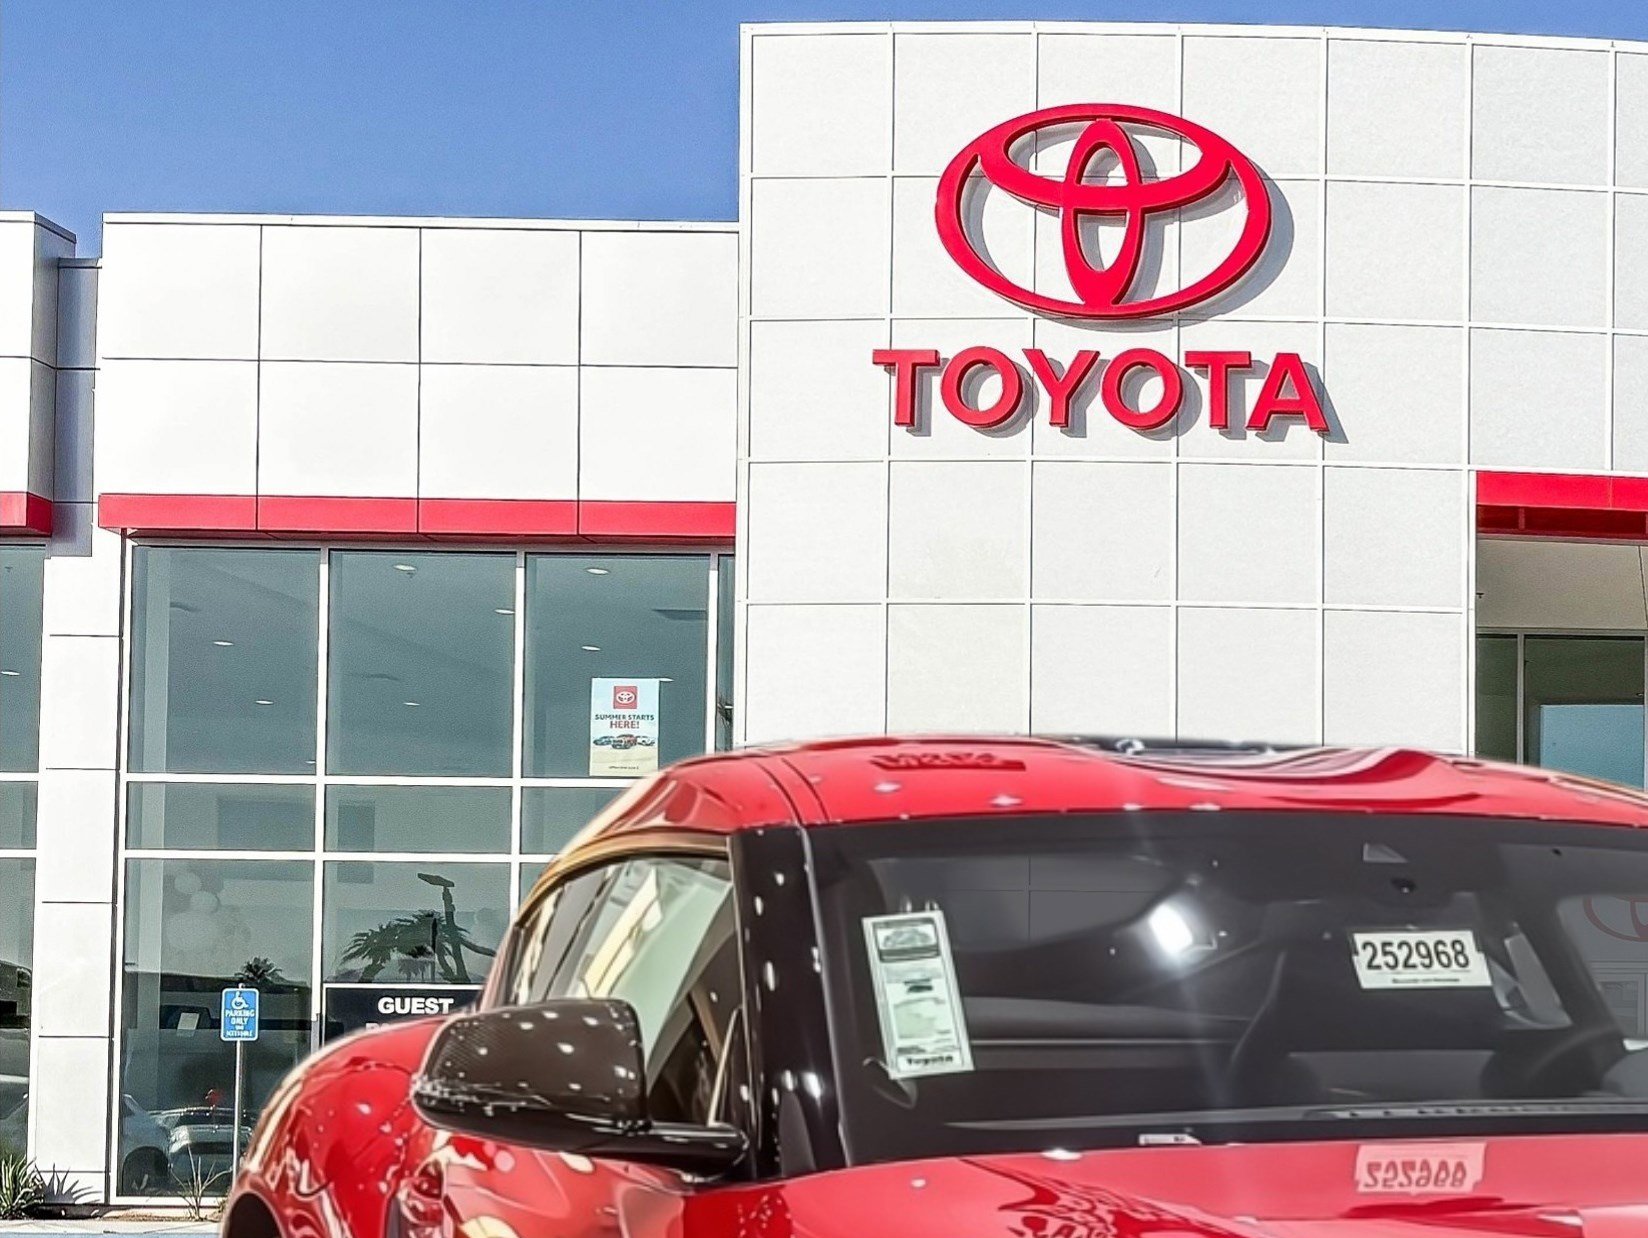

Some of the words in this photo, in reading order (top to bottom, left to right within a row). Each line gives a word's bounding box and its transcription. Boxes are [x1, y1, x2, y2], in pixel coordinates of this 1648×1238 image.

[872, 345, 1331, 433] TOYOTA
[609, 721, 640, 729] HERE!
[1361, 939, 1470, 971] 252968
[377, 996, 454, 1015] GUEST
[225, 1009, 255, 1017] PARKING
[230, 1017, 249, 1025] ONLY
